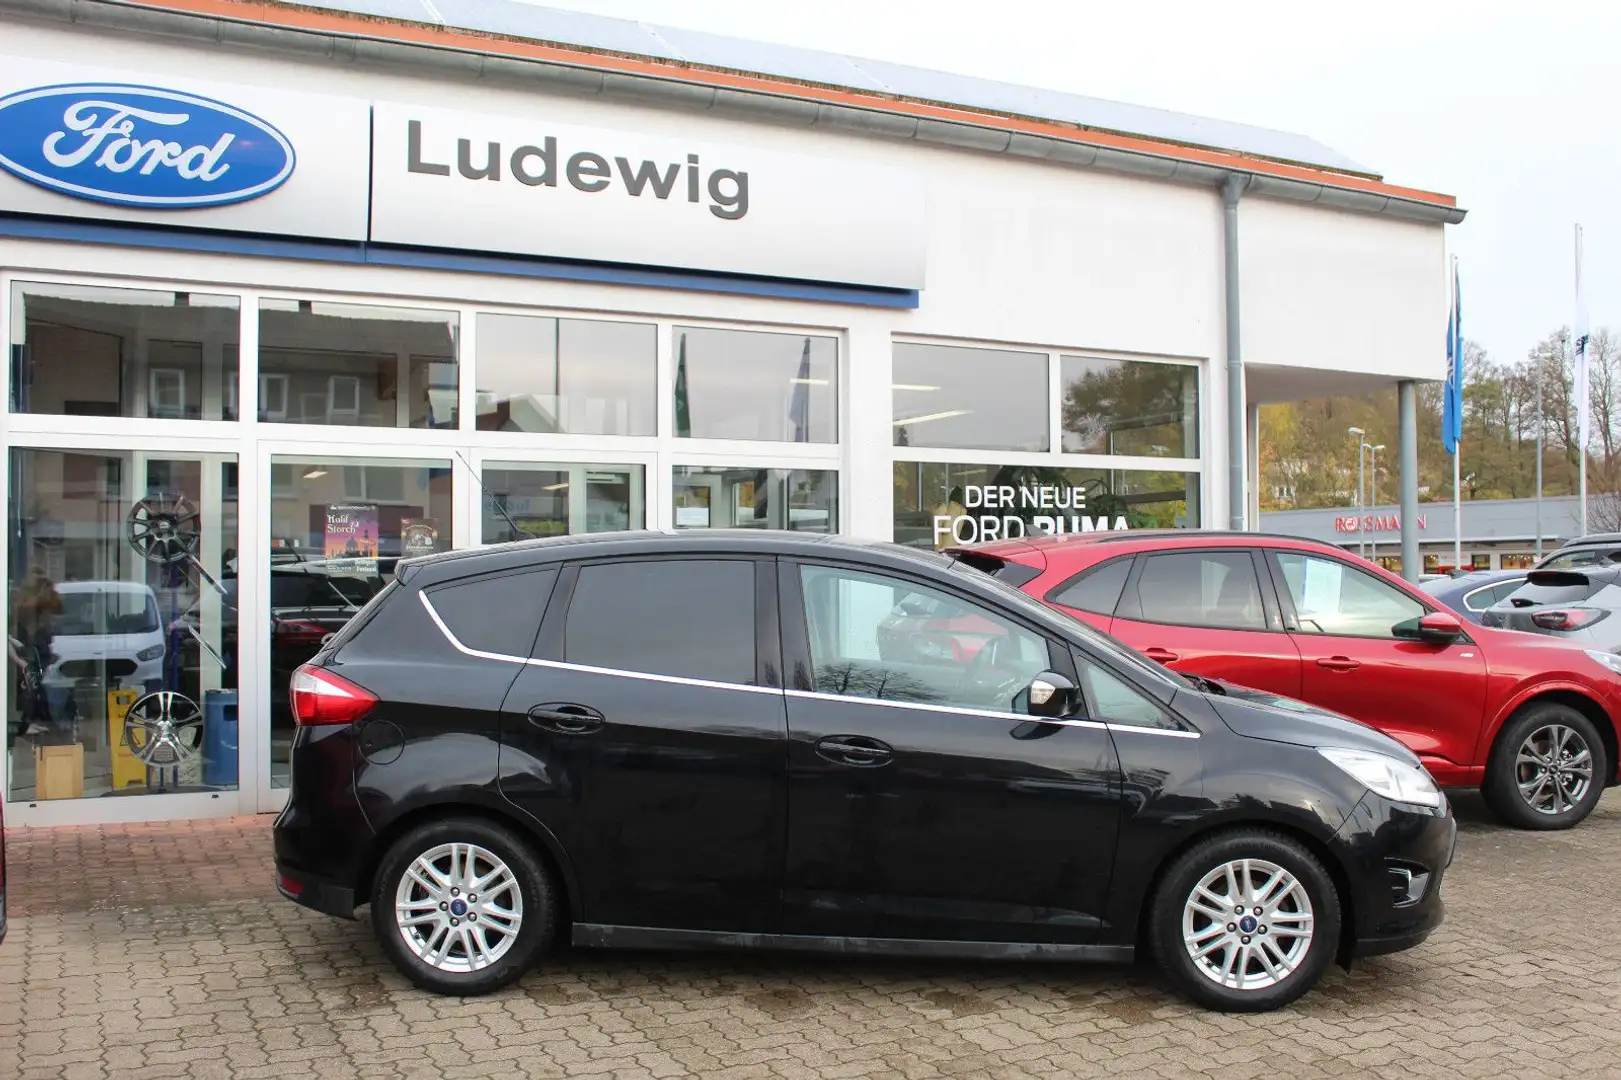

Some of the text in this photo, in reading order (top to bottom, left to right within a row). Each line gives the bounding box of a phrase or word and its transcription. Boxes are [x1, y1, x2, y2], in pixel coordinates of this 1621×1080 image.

[43, 100, 236, 182] Ford
[407, 119, 749, 220] Ludewig
[965, 485, 1087, 509] DER NEUE
[327, 523, 356, 534] Storch
[933, 515, 1025, 545] FORD
[1335, 514, 1427, 532] ROSSMAN
